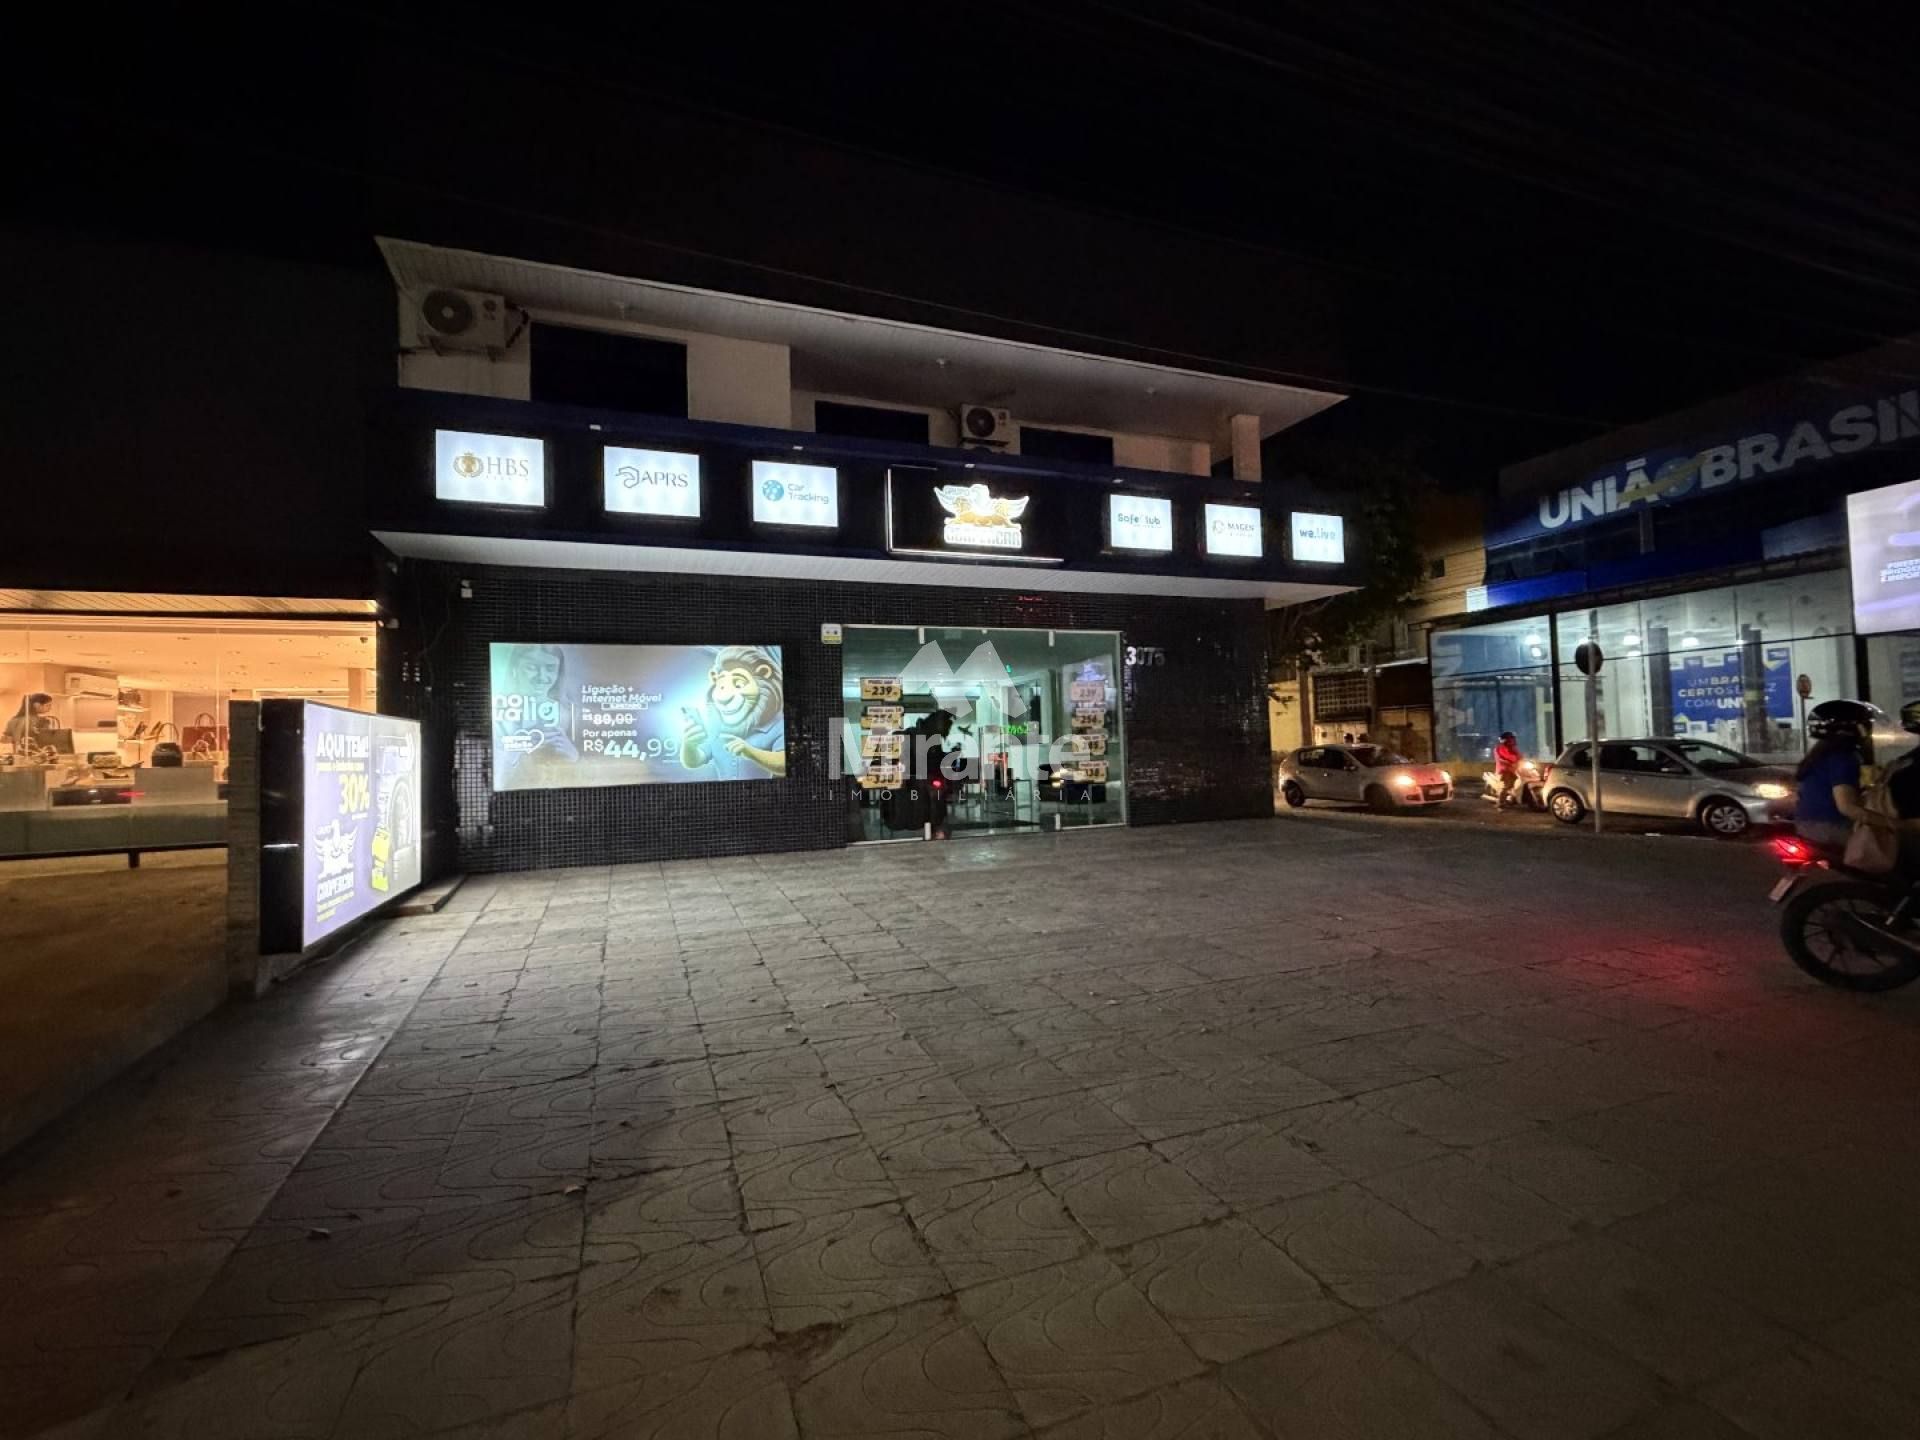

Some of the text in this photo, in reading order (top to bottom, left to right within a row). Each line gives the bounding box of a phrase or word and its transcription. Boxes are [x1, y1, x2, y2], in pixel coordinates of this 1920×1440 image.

[487, 456, 529, 477] HBS
[641, 471, 689, 488] APRS
[788, 483, 805, 492] Car
[788, 493, 829, 505] Tracking
[1117, 512, 1161, 525] Safelub
[1125, 646, 1166, 666] 3075
[582, 684, 625, 696] Ligação
[872, 686, 893, 696] 239
[1678, 687, 1725, 697] CERTO
[582, 692, 662, 703] Internet Móvel
[1685, 698, 1716, 708] COM
[523, 695, 560, 728] lig
[583, 729, 637, 739] Por apenas
[316, 732, 345, 760] AQUI
[339, 773, 369, 814] 30%
